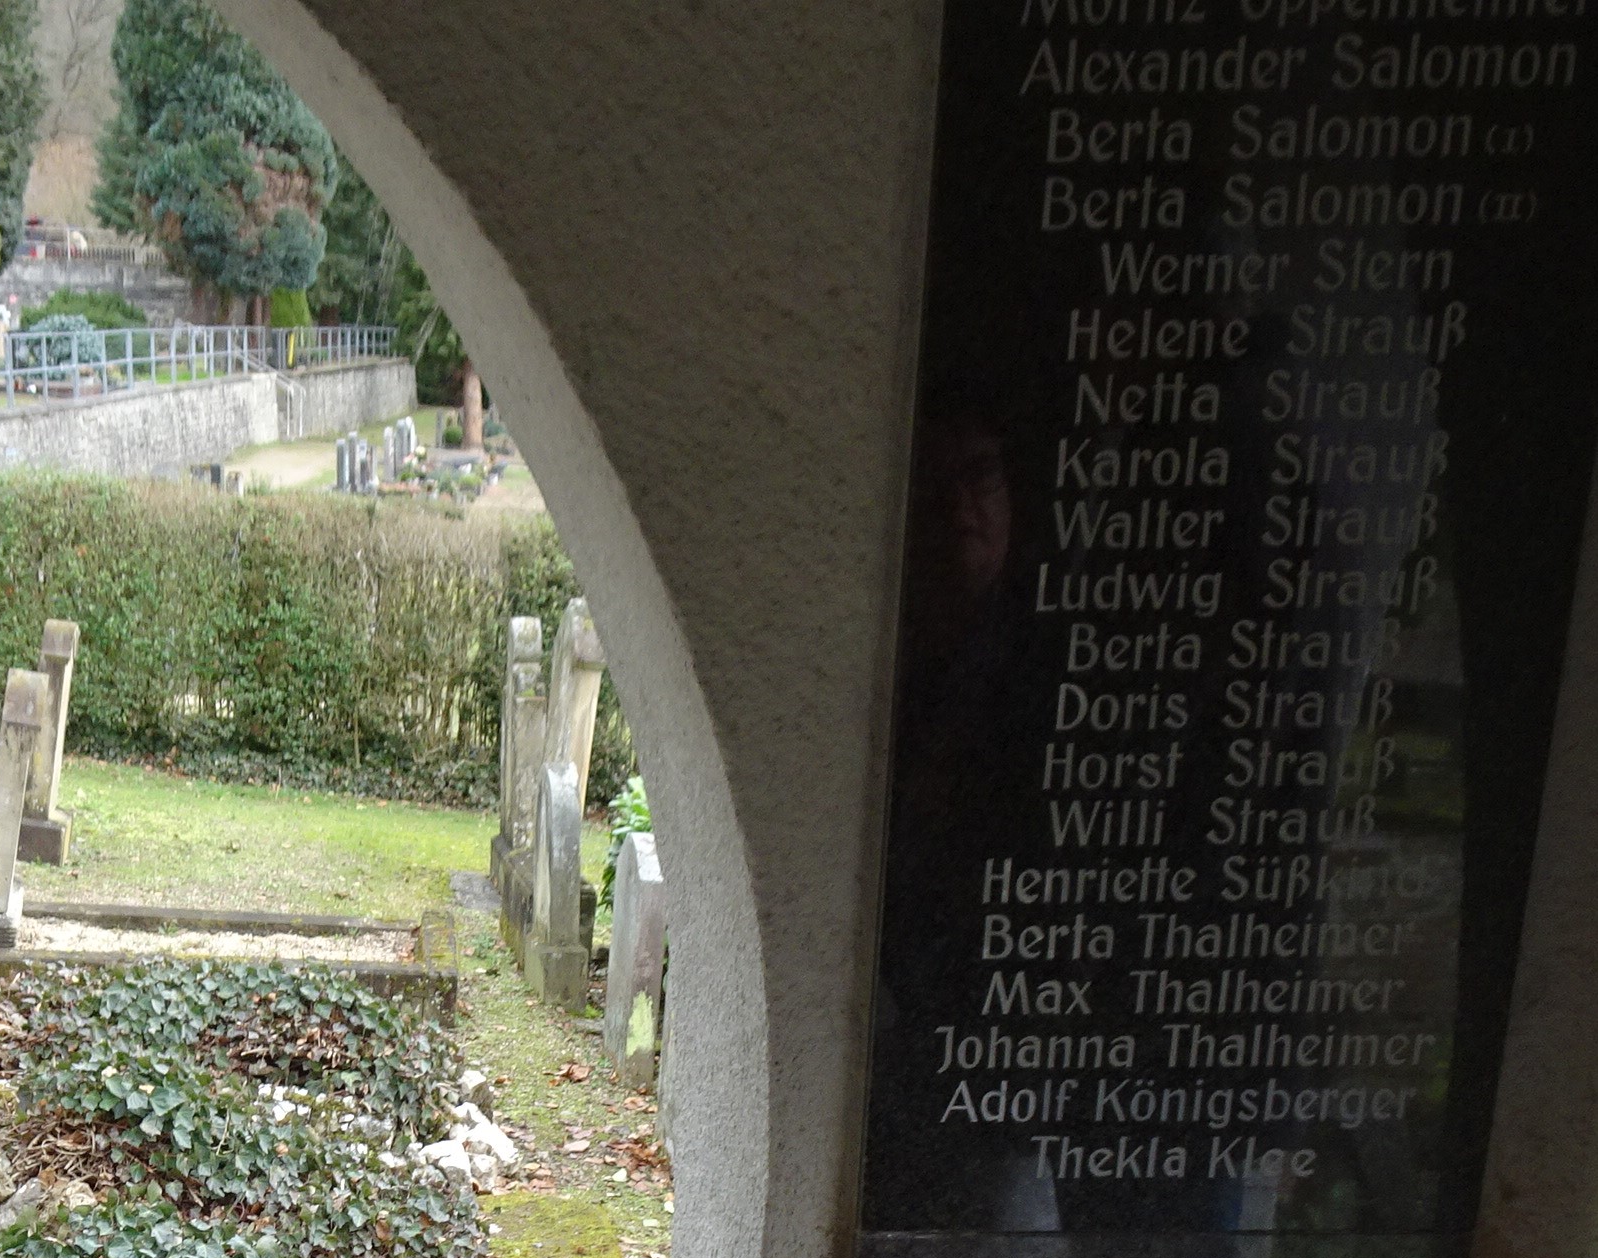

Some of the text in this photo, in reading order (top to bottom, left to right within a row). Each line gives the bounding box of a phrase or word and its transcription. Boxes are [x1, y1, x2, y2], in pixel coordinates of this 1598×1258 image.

[1019, 32, 1578, 95] Alexander Salomon
[1046, 106, 1194, 163] Berta
[1229, 103, 1473, 159] Salomon
[1040, 173, 1186, 231] Berta
[1222, 171, 1464, 228] Salomon
[1100, 237, 1455, 297] Werner Stern
[1066, 301, 1468, 363] Helene Strauß
[1074, 367, 1442, 426] Netta Strauß
[1056, 430, 1450, 488] Karola Strauß
[1054, 493, 1438, 550] Walter Strauß
[1036, 556, 1438, 617] Ludwig Strauß
[1066, 617, 1401, 673] Berta Strauß
[1055, 678, 1394, 733] Doris Strauß
[1042, 736, 1396, 790] Horst Strauß
[1048, 793, 1377, 847] Willi Strauß
[982, 856, 1198, 905] Henriette
[981, 912, 1415, 960] Berta Thalheimer
[981, 968, 1406, 1016] Max Thalheimer
[935, 1023, 1437, 1074] Johanna Thalheimer
[940, 1077, 1418, 1130] Adolf Königsberger
[1031, 1134, 1318, 1180] Thekla Klee
